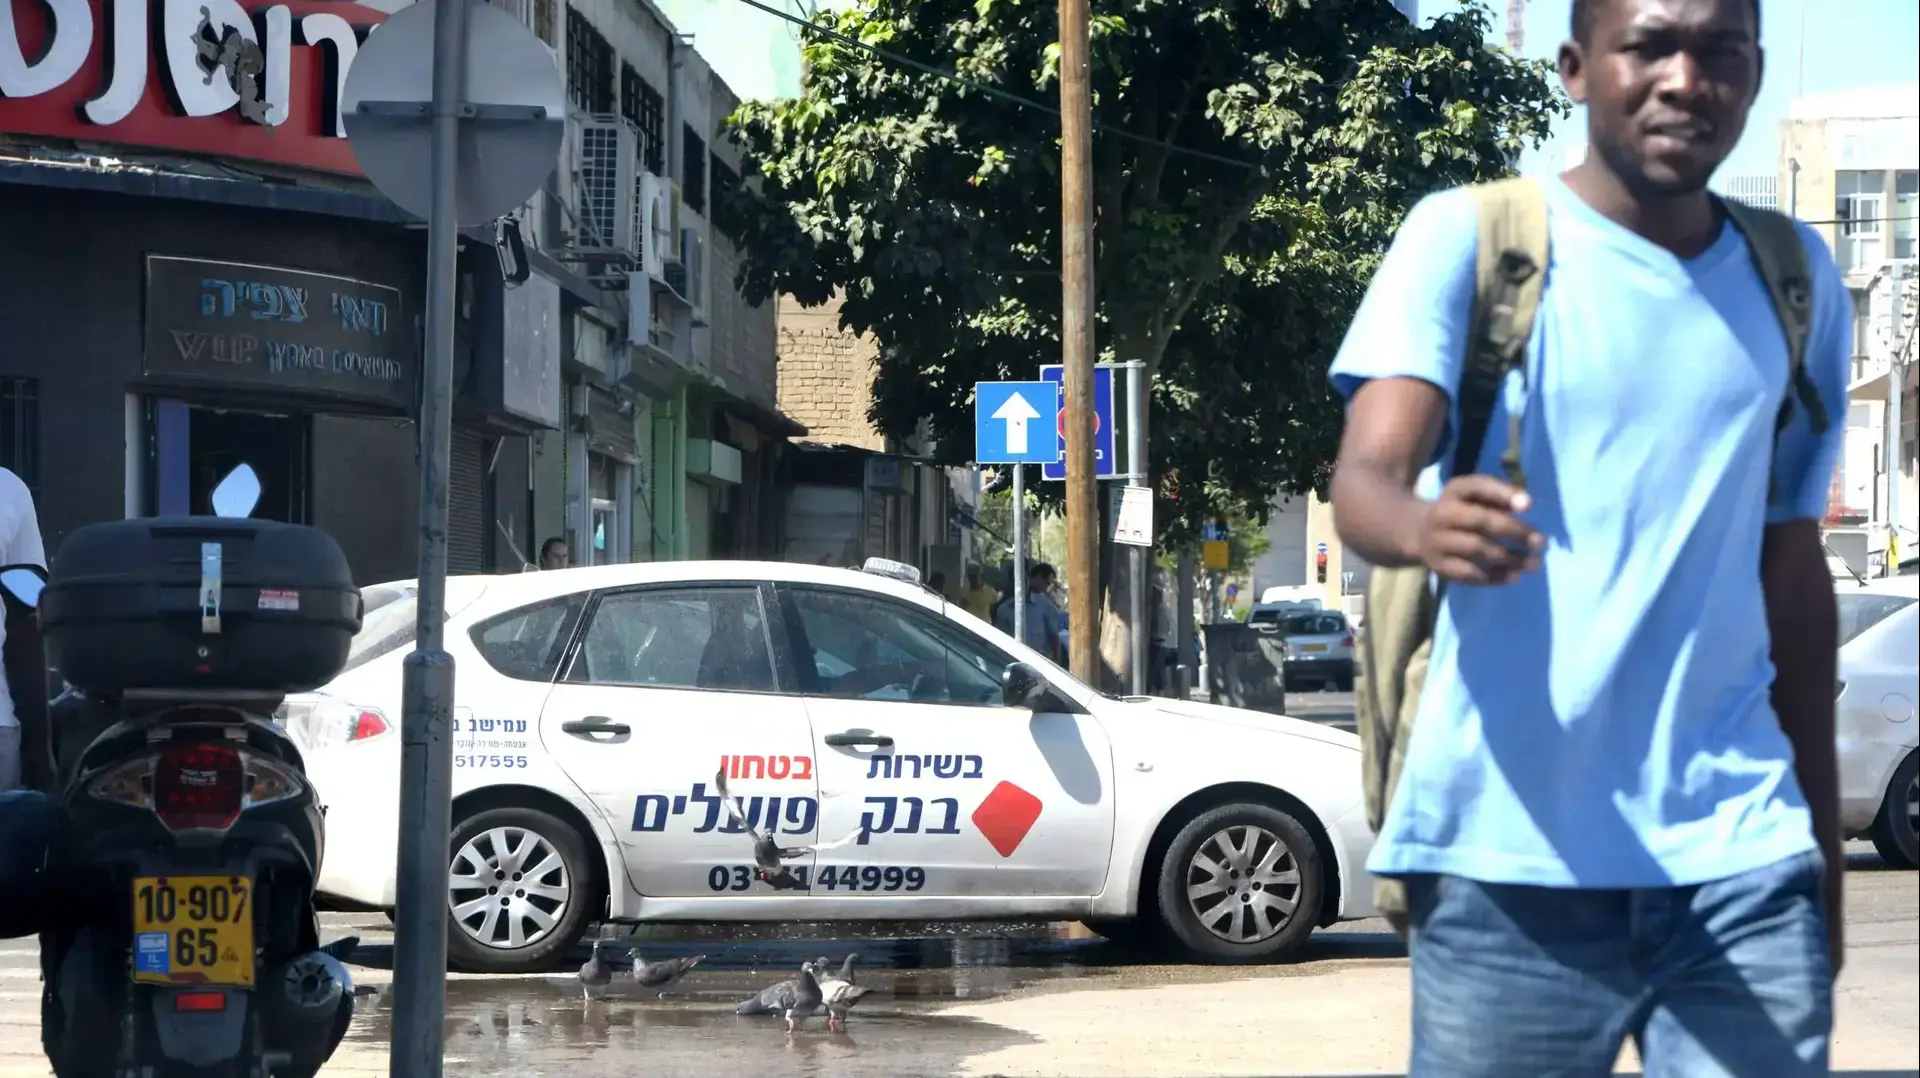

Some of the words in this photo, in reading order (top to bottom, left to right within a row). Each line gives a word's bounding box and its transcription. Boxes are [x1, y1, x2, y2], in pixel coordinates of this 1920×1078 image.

[201, 278, 308, 323] צפיה
[468, 719, 527, 733] עמישב
[720, 754, 812, 780] בטחון
[866, 754, 983, 779] בשירות
[631, 783, 818, 835] פועלים
[856, 796, 961, 846] בנק
[708, 865, 926, 892] 03-144999
[176, 928, 218, 967] 65
